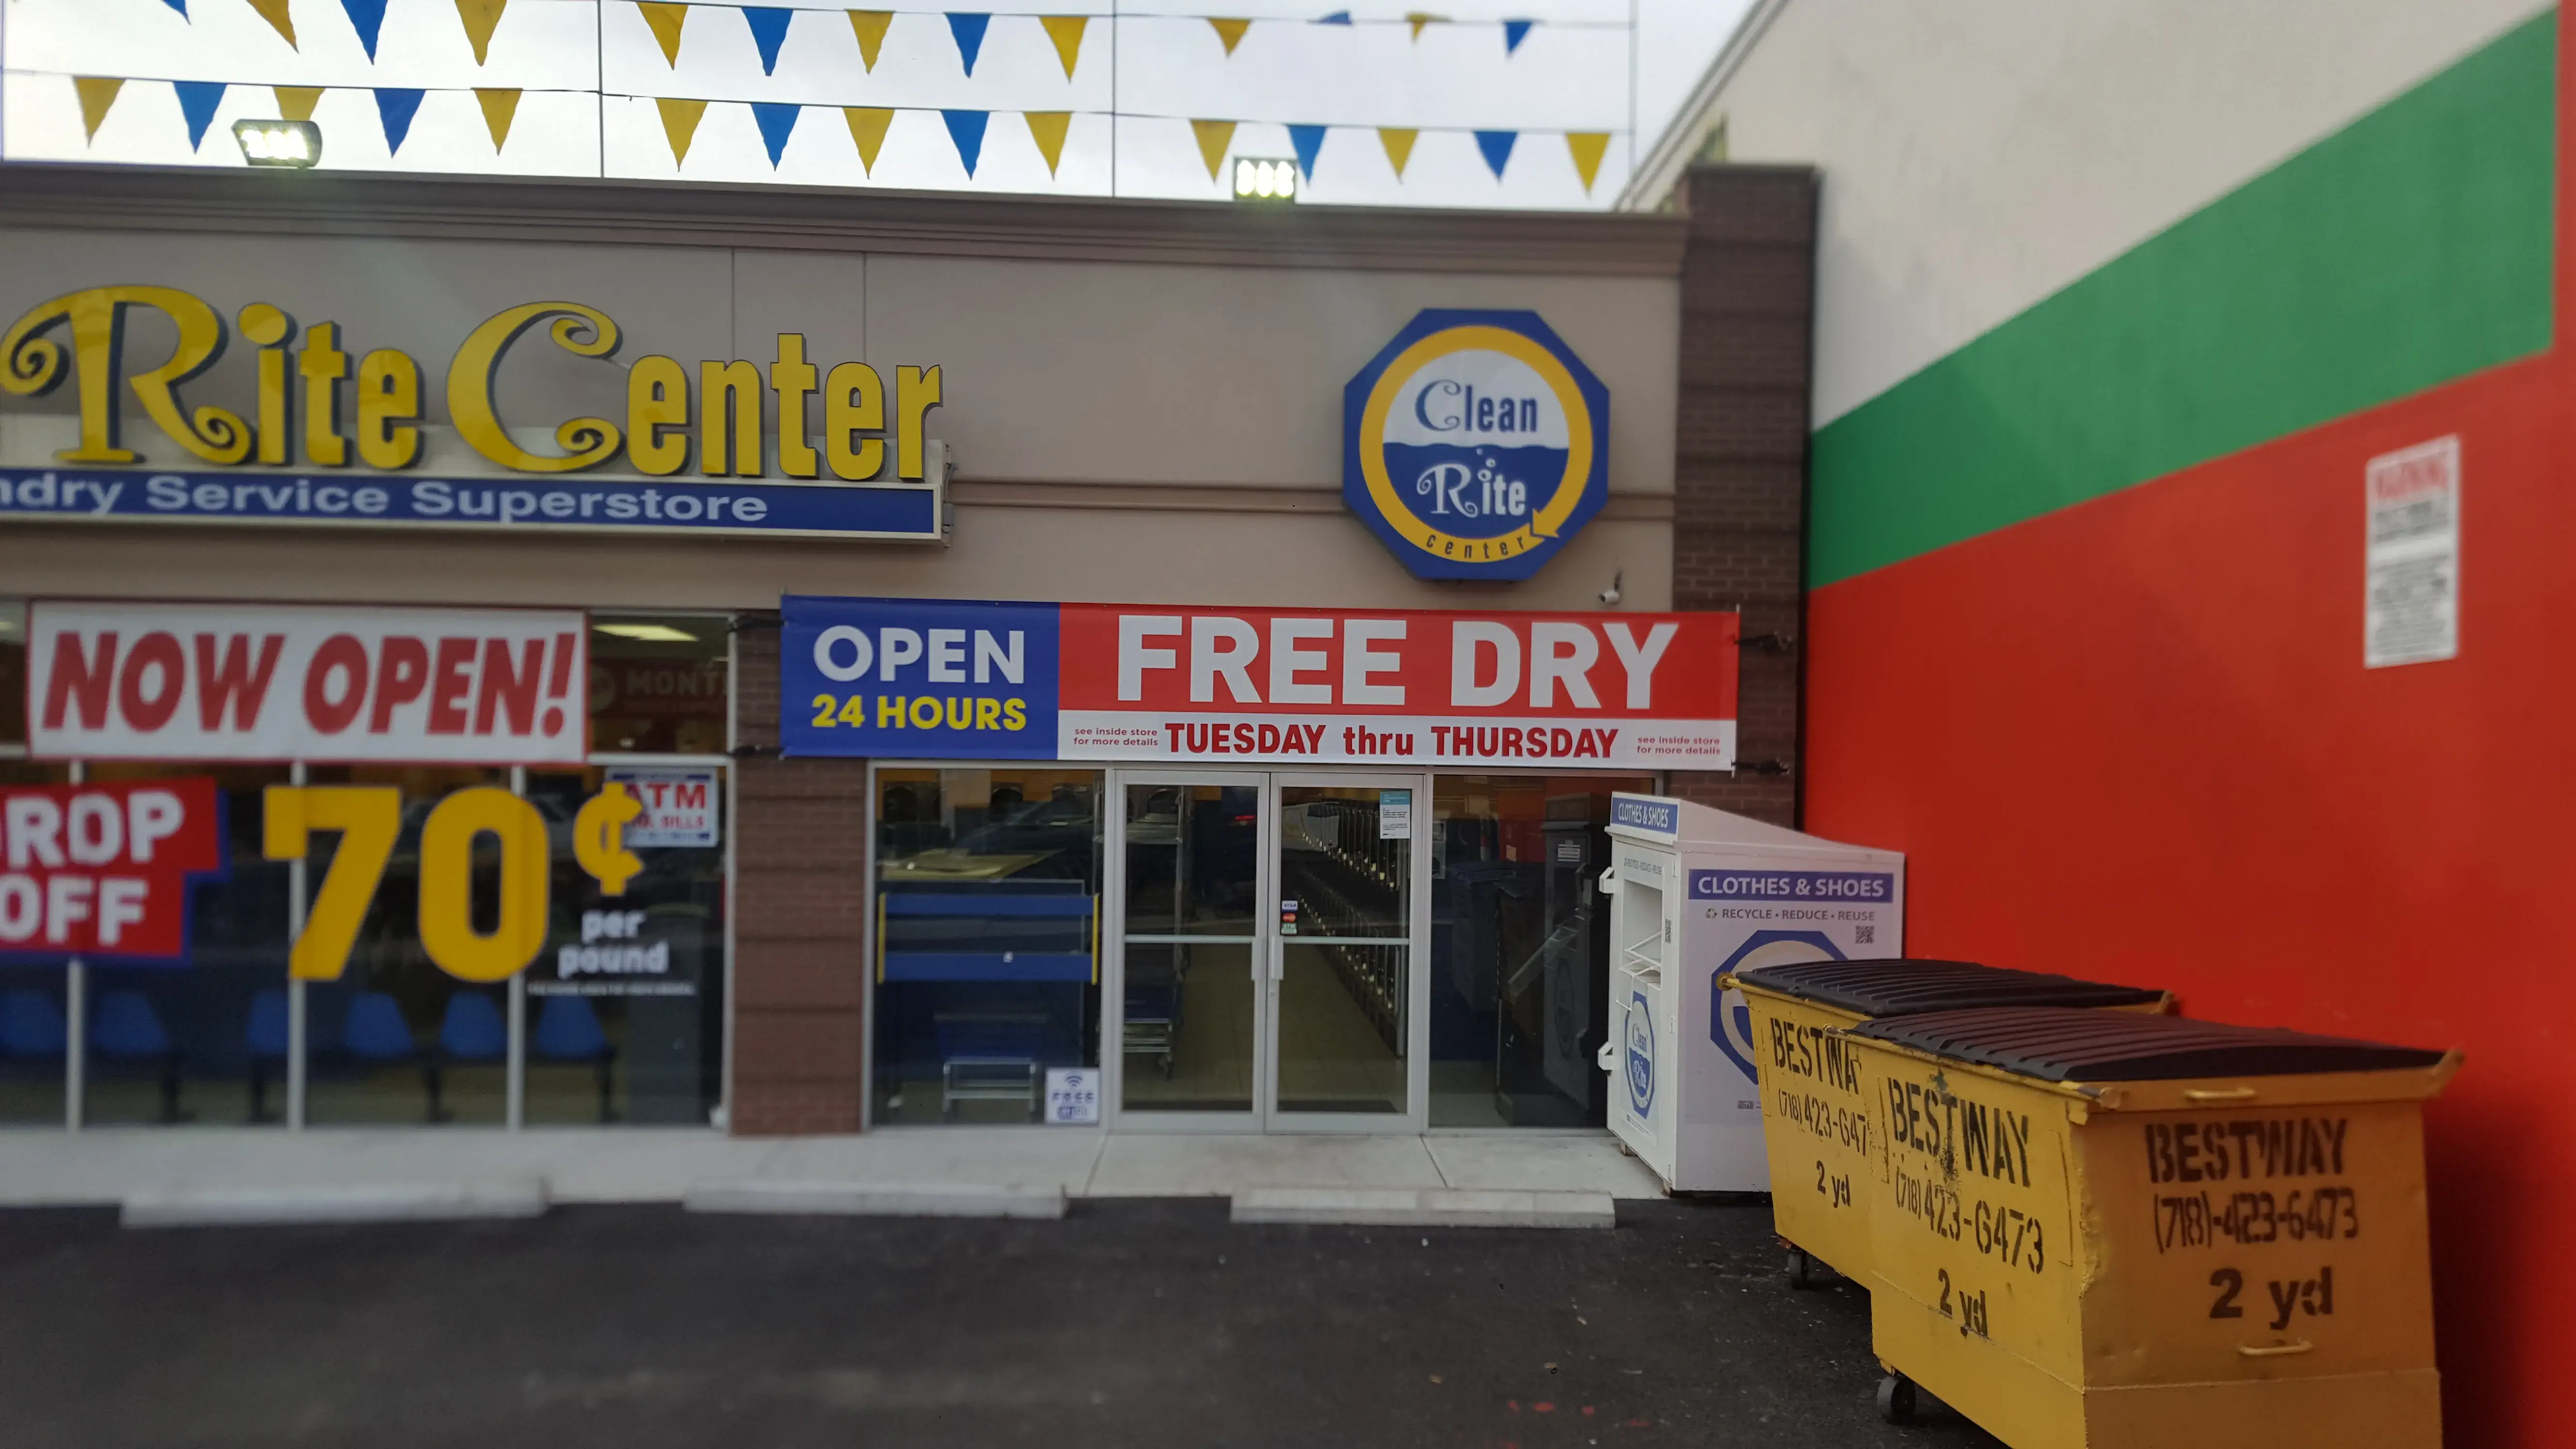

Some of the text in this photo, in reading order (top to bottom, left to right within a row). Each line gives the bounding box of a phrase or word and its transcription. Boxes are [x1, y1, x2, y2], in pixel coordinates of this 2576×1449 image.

[0, 285, 943, 481] Rite Center
[1415, 379, 1538, 433] Clean
[146, 474, 389, 513] Service
[411, 480, 768, 523] Superstore
[1417, 463, 1526, 517] Rite
[1426, 534, 1524, 560] center
[813, 625, 1024, 684] OPEN
[1118, 614, 1679, 710] FREE DRY
[42, 630, 577, 738] NOW OPEN!
[812, 694, 1027, 731] 24 HOURS
[1165, 723, 1619, 758] TUESDAY thru THURSDAY
[1659, 736, 1690, 744] inside
[1686, 746, 1721, 755] details
[0, 789, 185, 868] ROP
[1618, 803, 1669, 828] CLOTHES & SHOES
[0, 874, 149, 947] OFF
[1698, 877, 1884, 897] CLOTHES & SHOES
[581, 909, 646, 945] per
[1722, 908, 1875, 921] RECYCLE REDUCE REUSE
[558, 939, 669, 981] pound
[1771, 1017, 1859, 1095] BESTWA
[1887, 1077, 2032, 1188] BESTWAY
[2144, 1119, 2347, 1184] BESTWAY
[1816, 1160, 1851, 1208] 2 yd
[1938, 1269, 1989, 1340] 2 yd
[2209, 1266, 2334, 1330] 2 yd
